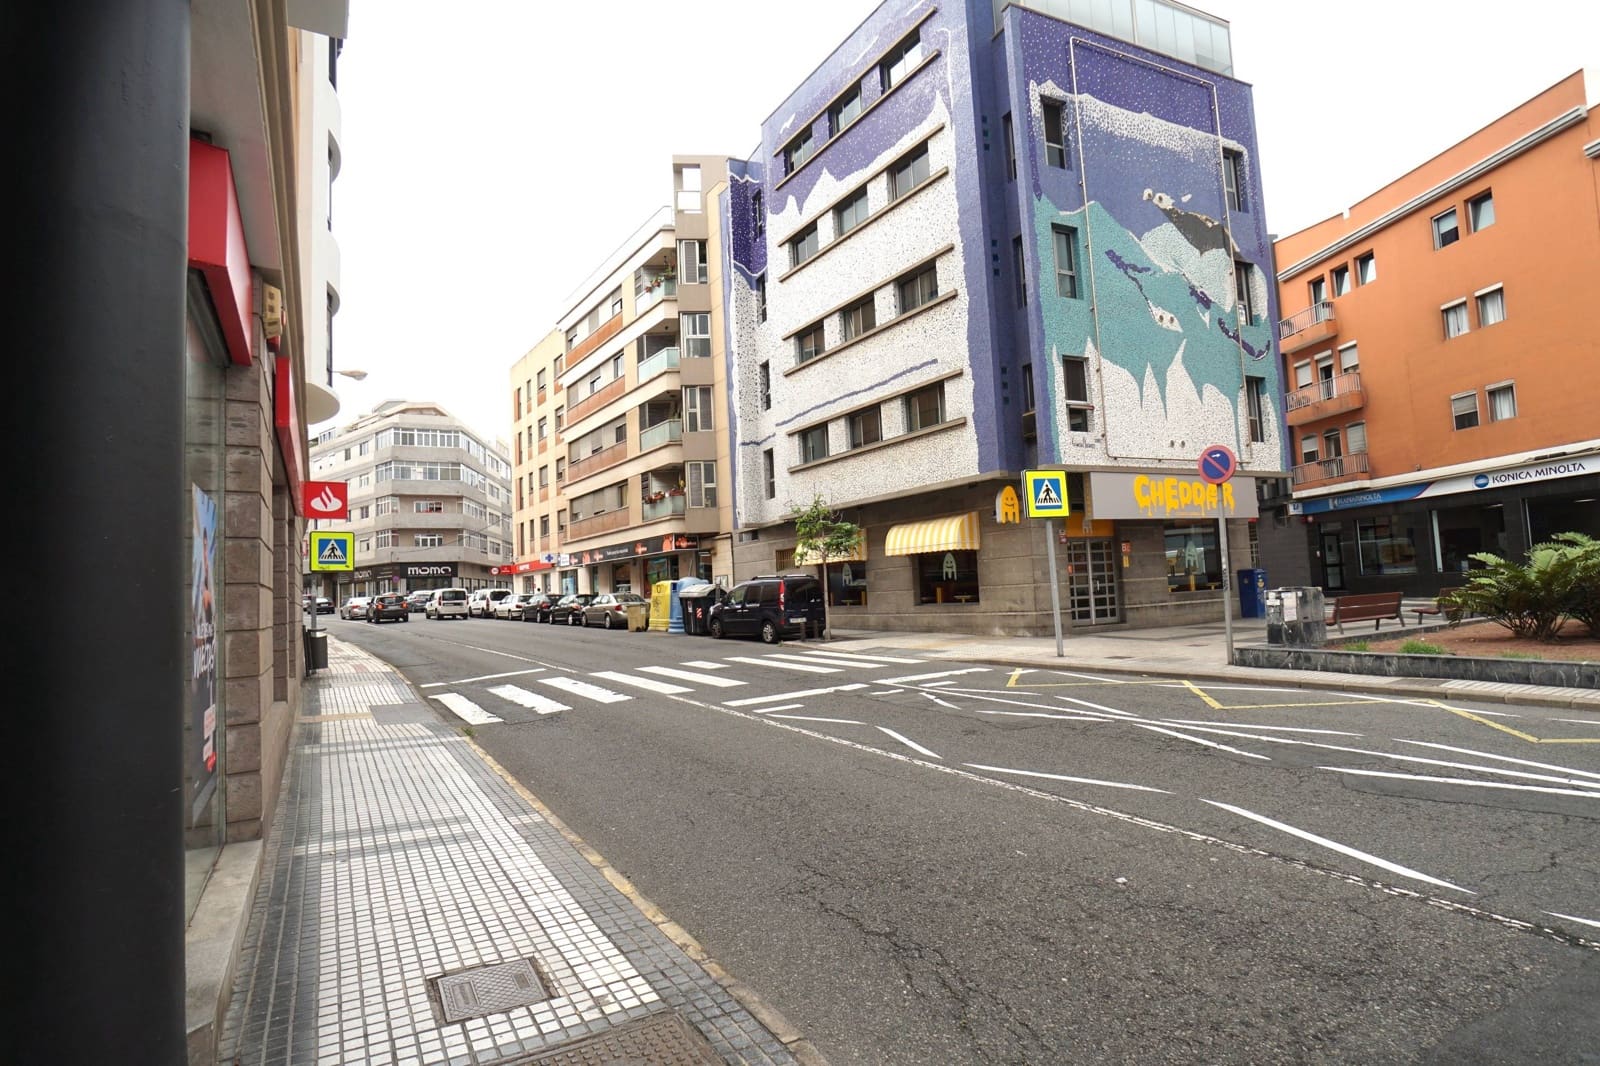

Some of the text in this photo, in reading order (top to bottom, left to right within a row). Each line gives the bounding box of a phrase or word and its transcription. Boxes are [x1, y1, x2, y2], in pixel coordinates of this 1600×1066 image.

[1492, 463, 1586, 484] KONICA MINOLTA
[1133, 475, 1236, 517] CHEDDAR
